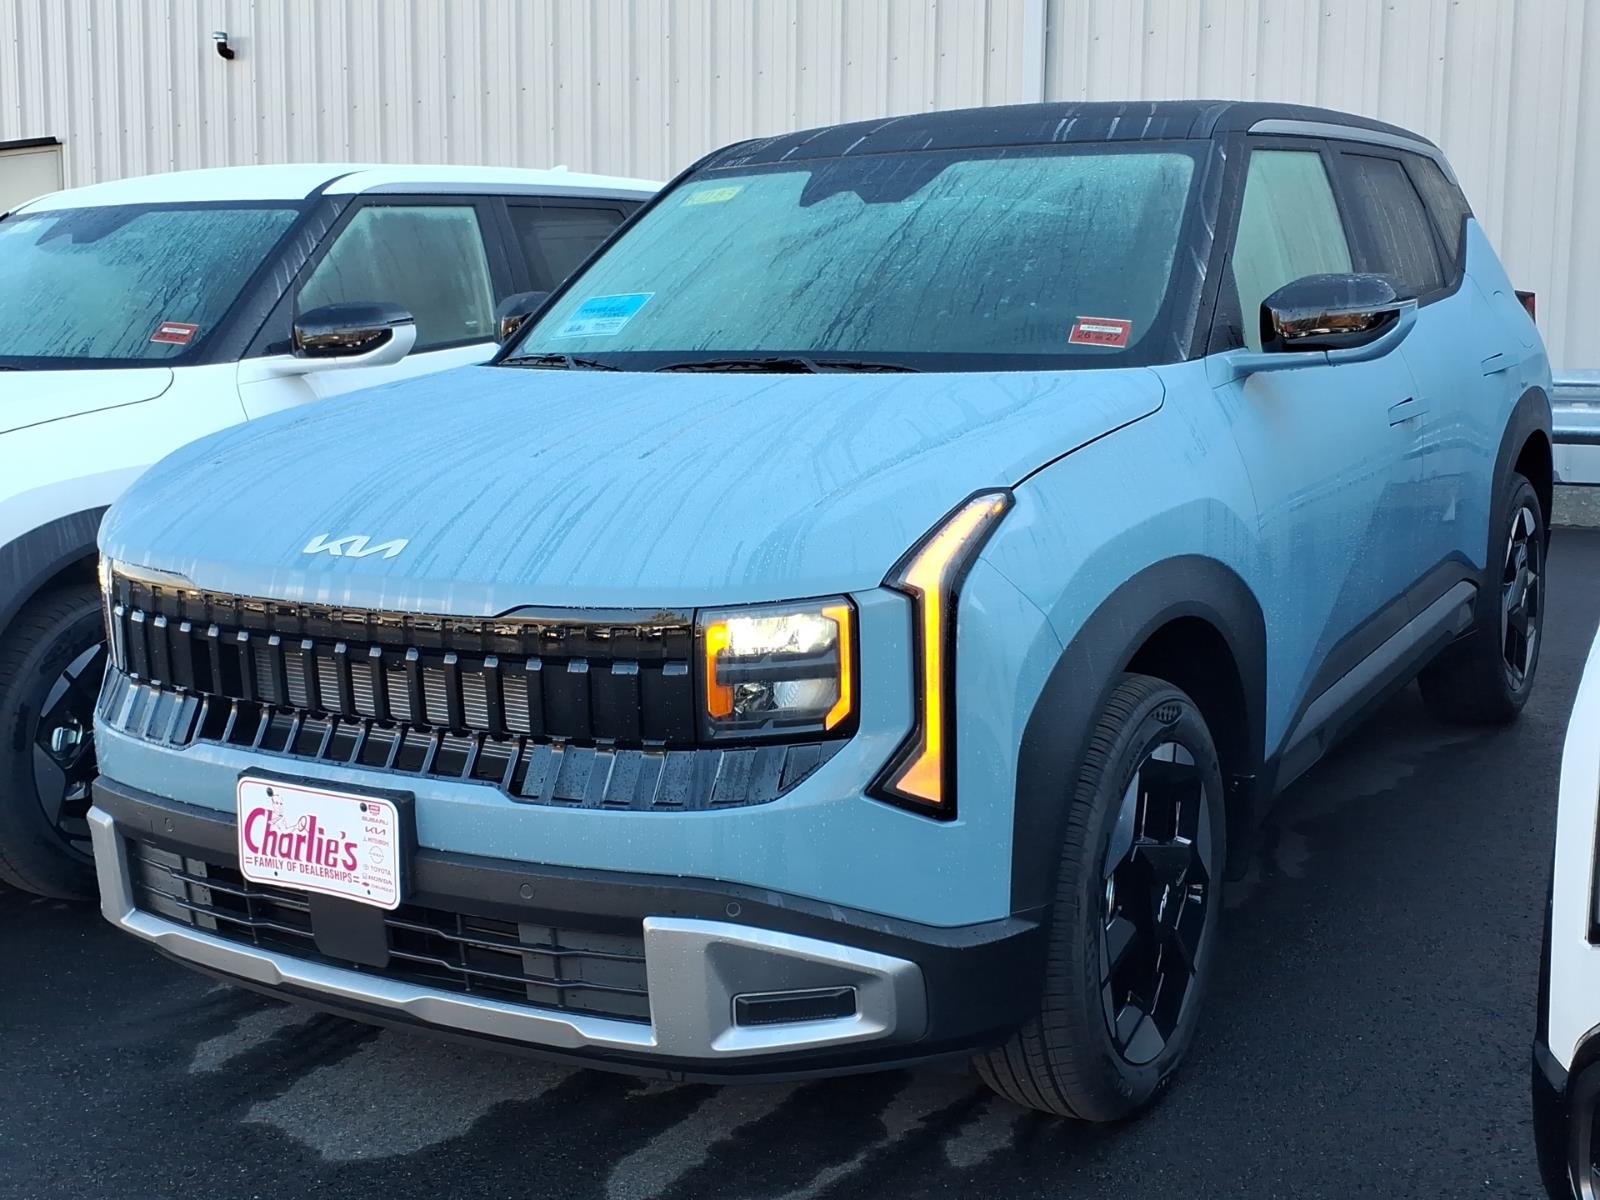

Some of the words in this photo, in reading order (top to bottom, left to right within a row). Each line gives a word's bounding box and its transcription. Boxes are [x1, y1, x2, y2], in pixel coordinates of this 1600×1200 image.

[303, 533, 409, 559] KIA
[244, 807, 358, 871] Charlie's
[365, 826, 386, 836] KIA
[254, 856, 284, 870] FAMILY
[286, 862, 297, 872] OF
[299, 863, 353, 884] DEALERSHIPS
[371, 866, 391, 876] TOYOTA
[368, 875, 393, 886] HONDA
